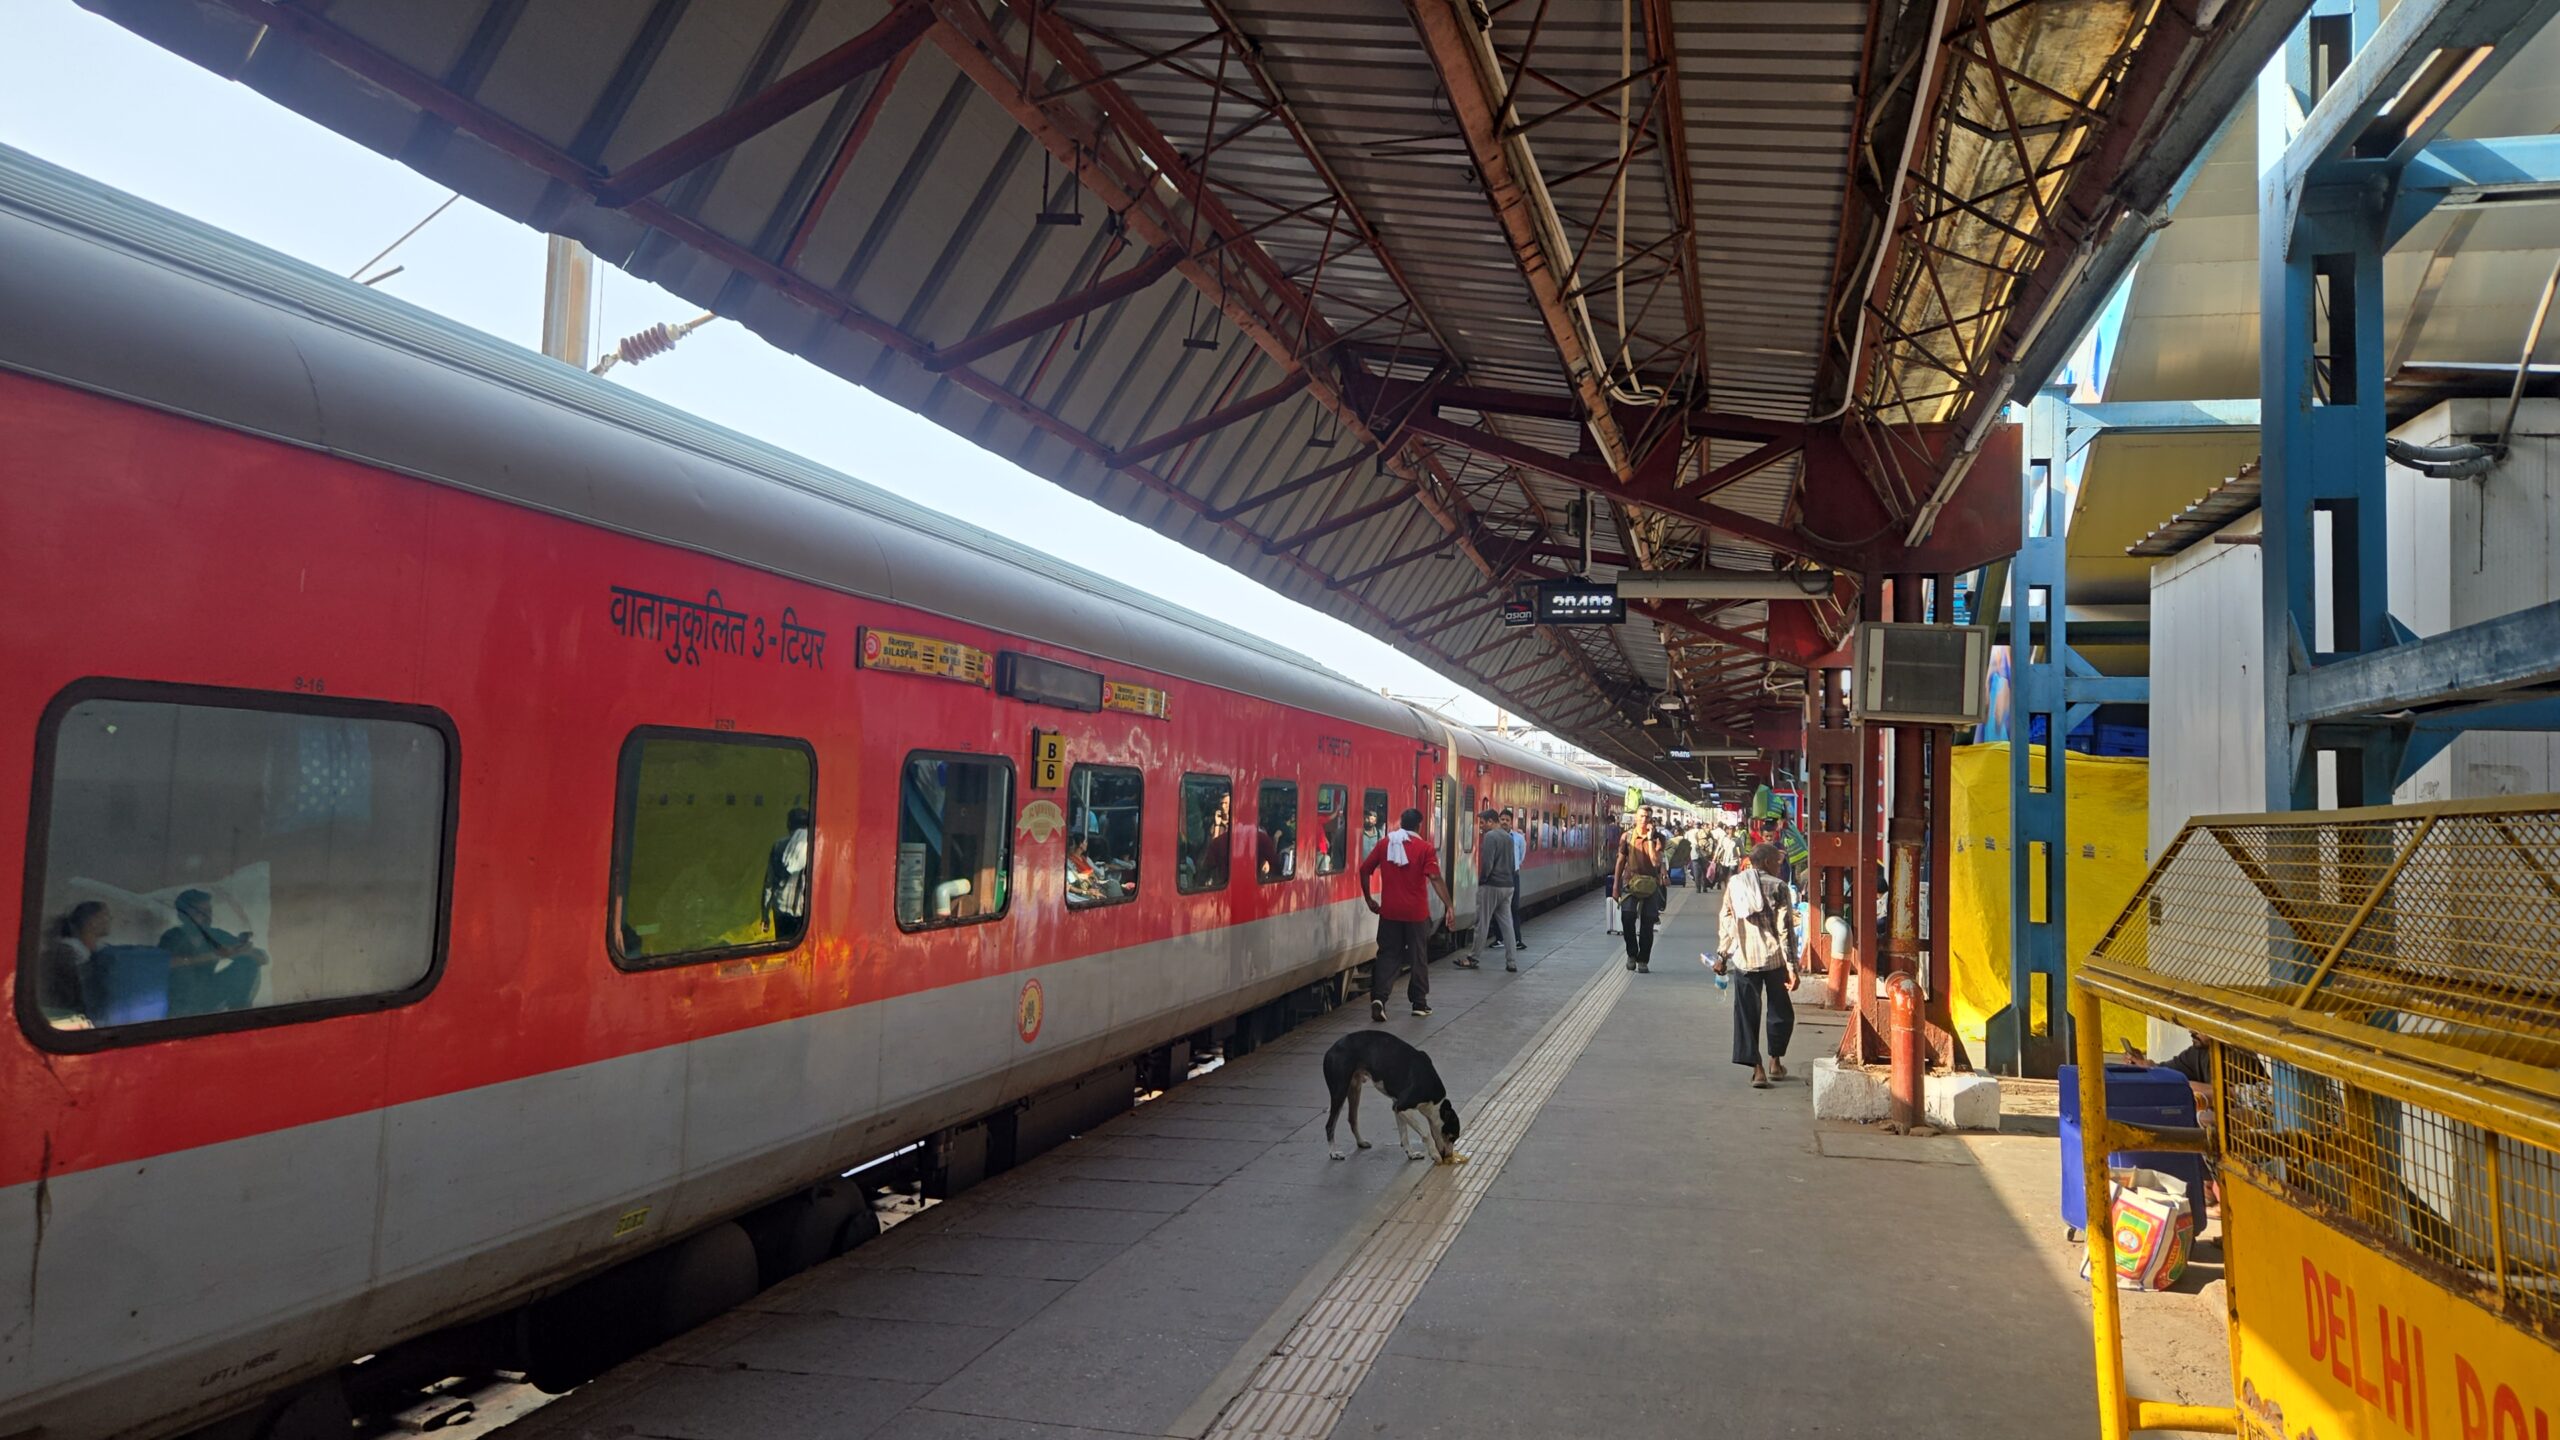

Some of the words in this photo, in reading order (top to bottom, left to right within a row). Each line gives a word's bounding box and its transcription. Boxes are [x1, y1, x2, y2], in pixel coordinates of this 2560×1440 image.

[1505, 611, 1532, 620] asian
[610, 585, 749, 667] वातानुकूलित
[883, 646, 918, 659] BILASPUR
[294, 676, 326, 693] 9-16
[1047, 742, 1058, 759] B
[1046, 763, 1056, 781] 6
[2301, 1255, 2431, 1440] DELHI
[2454, 1352, 2549, 1440] PO
